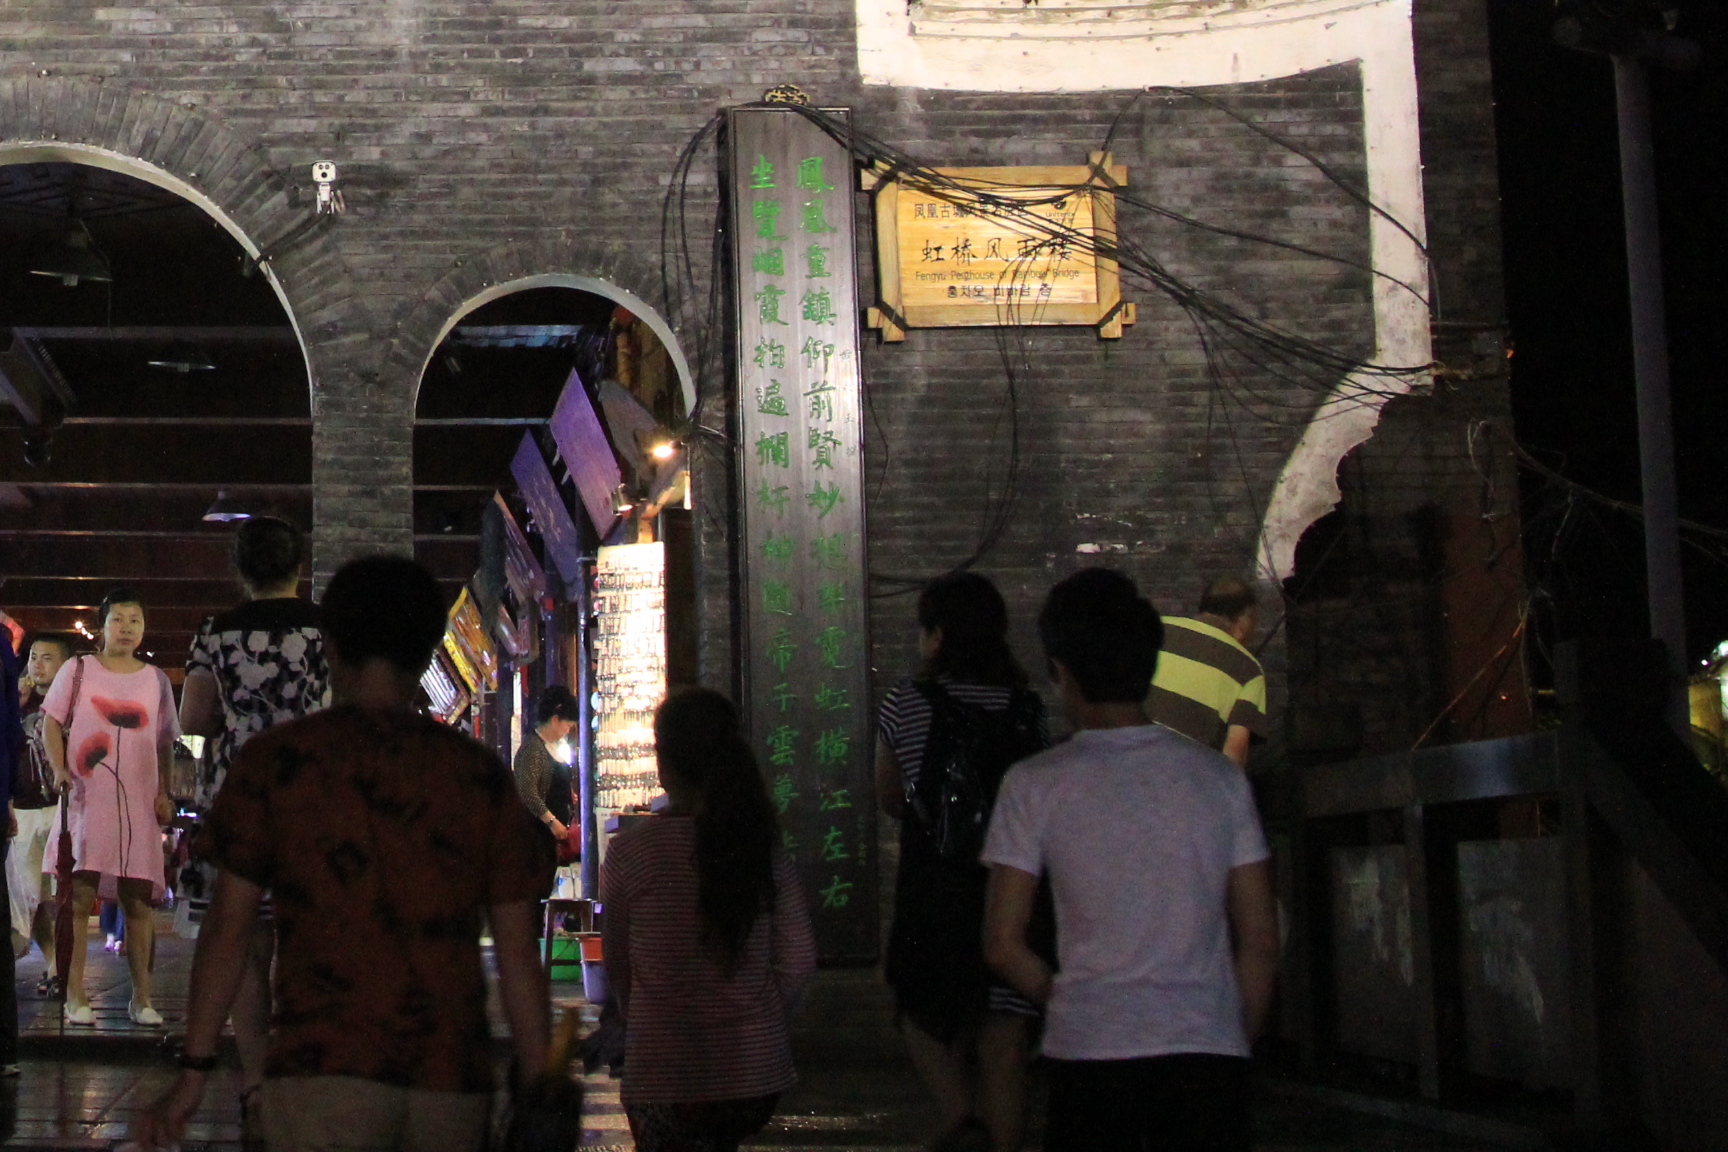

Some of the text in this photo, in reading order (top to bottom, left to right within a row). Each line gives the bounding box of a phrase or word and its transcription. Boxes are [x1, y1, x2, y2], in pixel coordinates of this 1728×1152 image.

[915, 271, 946, 282] Fengyu
[951, 270, 994, 280] Penthouse
[1012, 269, 1048, 279] Rainbow
[1052, 268, 1079, 279] Bridge
